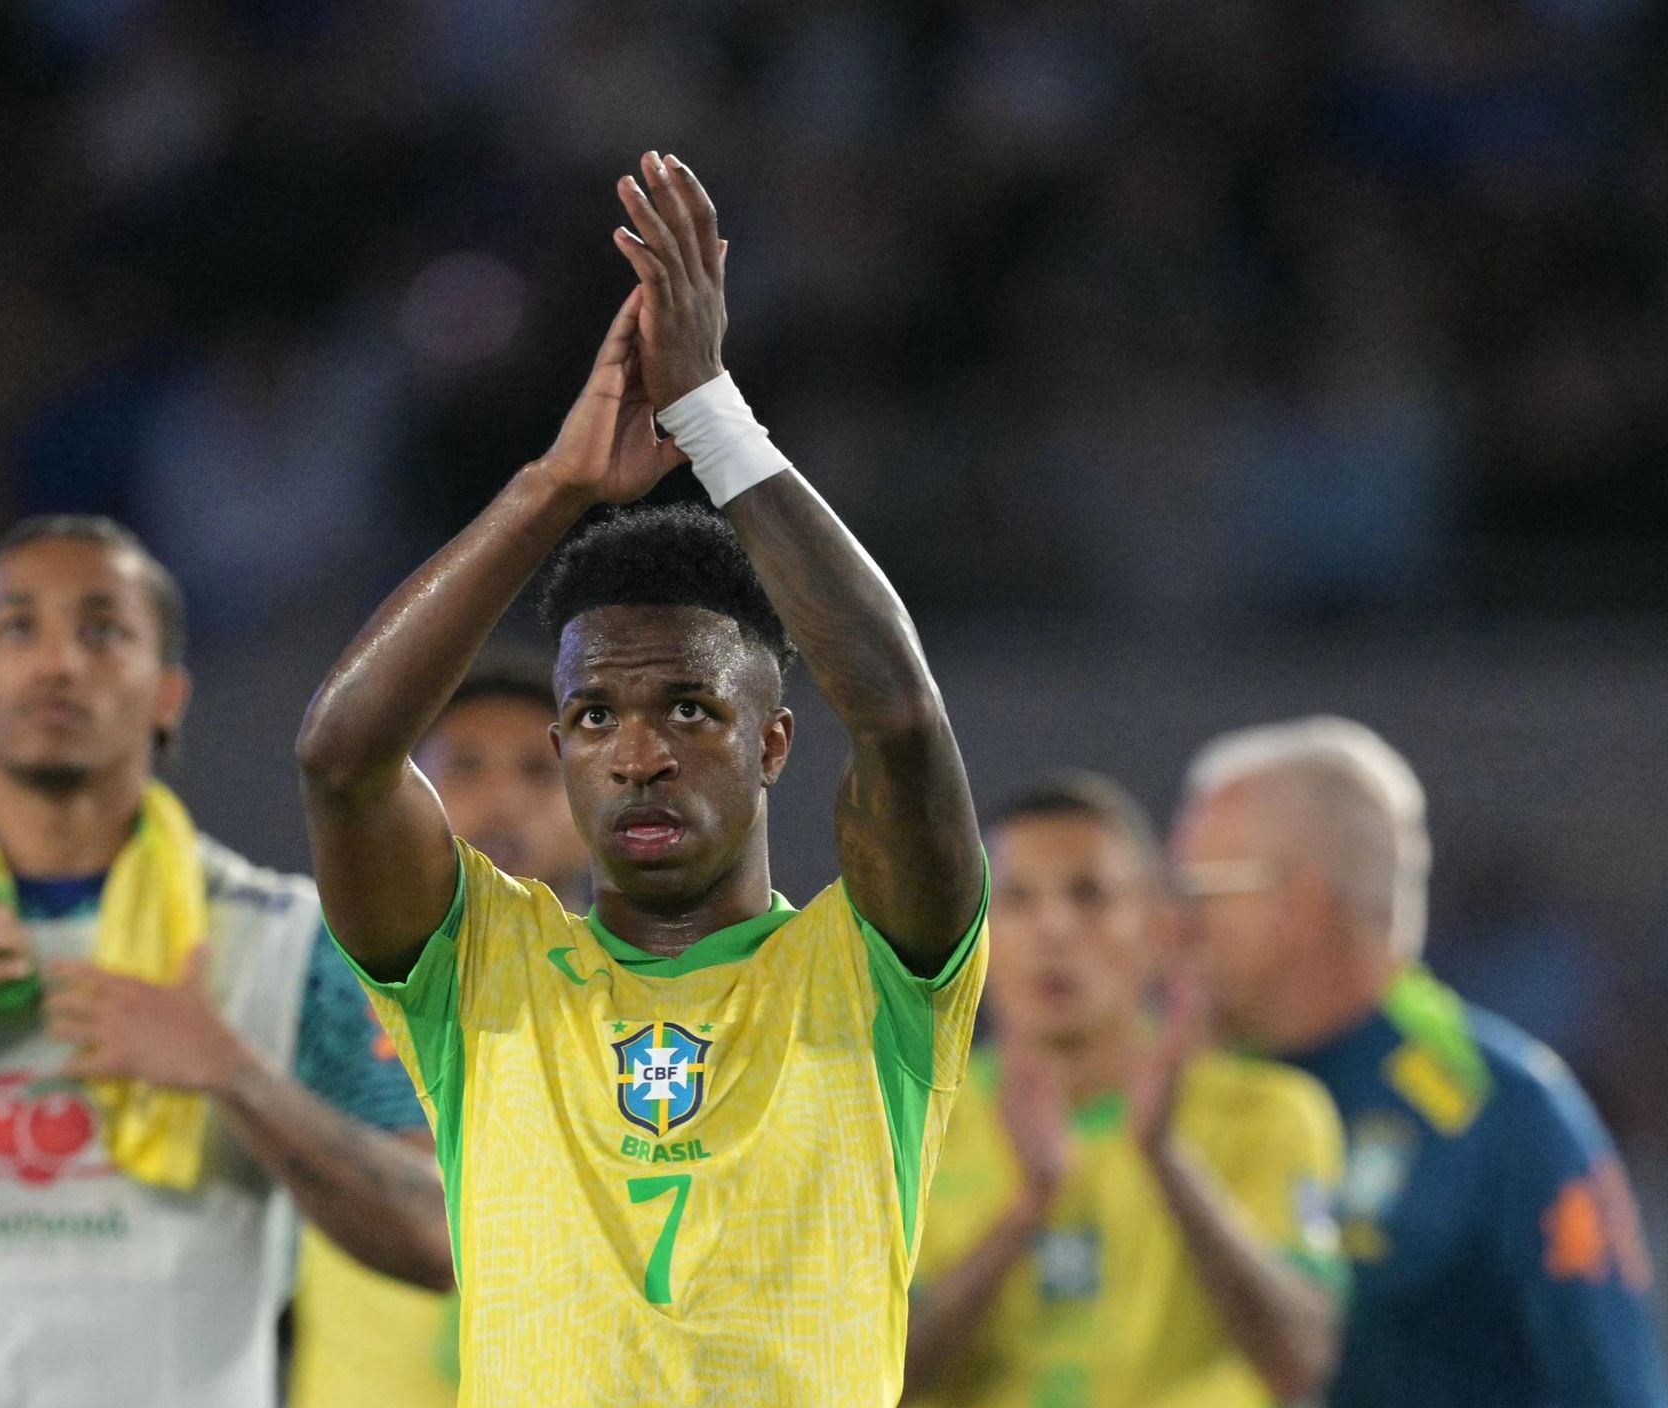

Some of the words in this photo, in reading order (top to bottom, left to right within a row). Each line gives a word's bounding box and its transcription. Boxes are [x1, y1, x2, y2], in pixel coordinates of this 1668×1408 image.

[643, 1066, 678, 1081] CBF
[620, 1135, 711, 1163] BRASIL
[627, 1174, 692, 1304] 7
